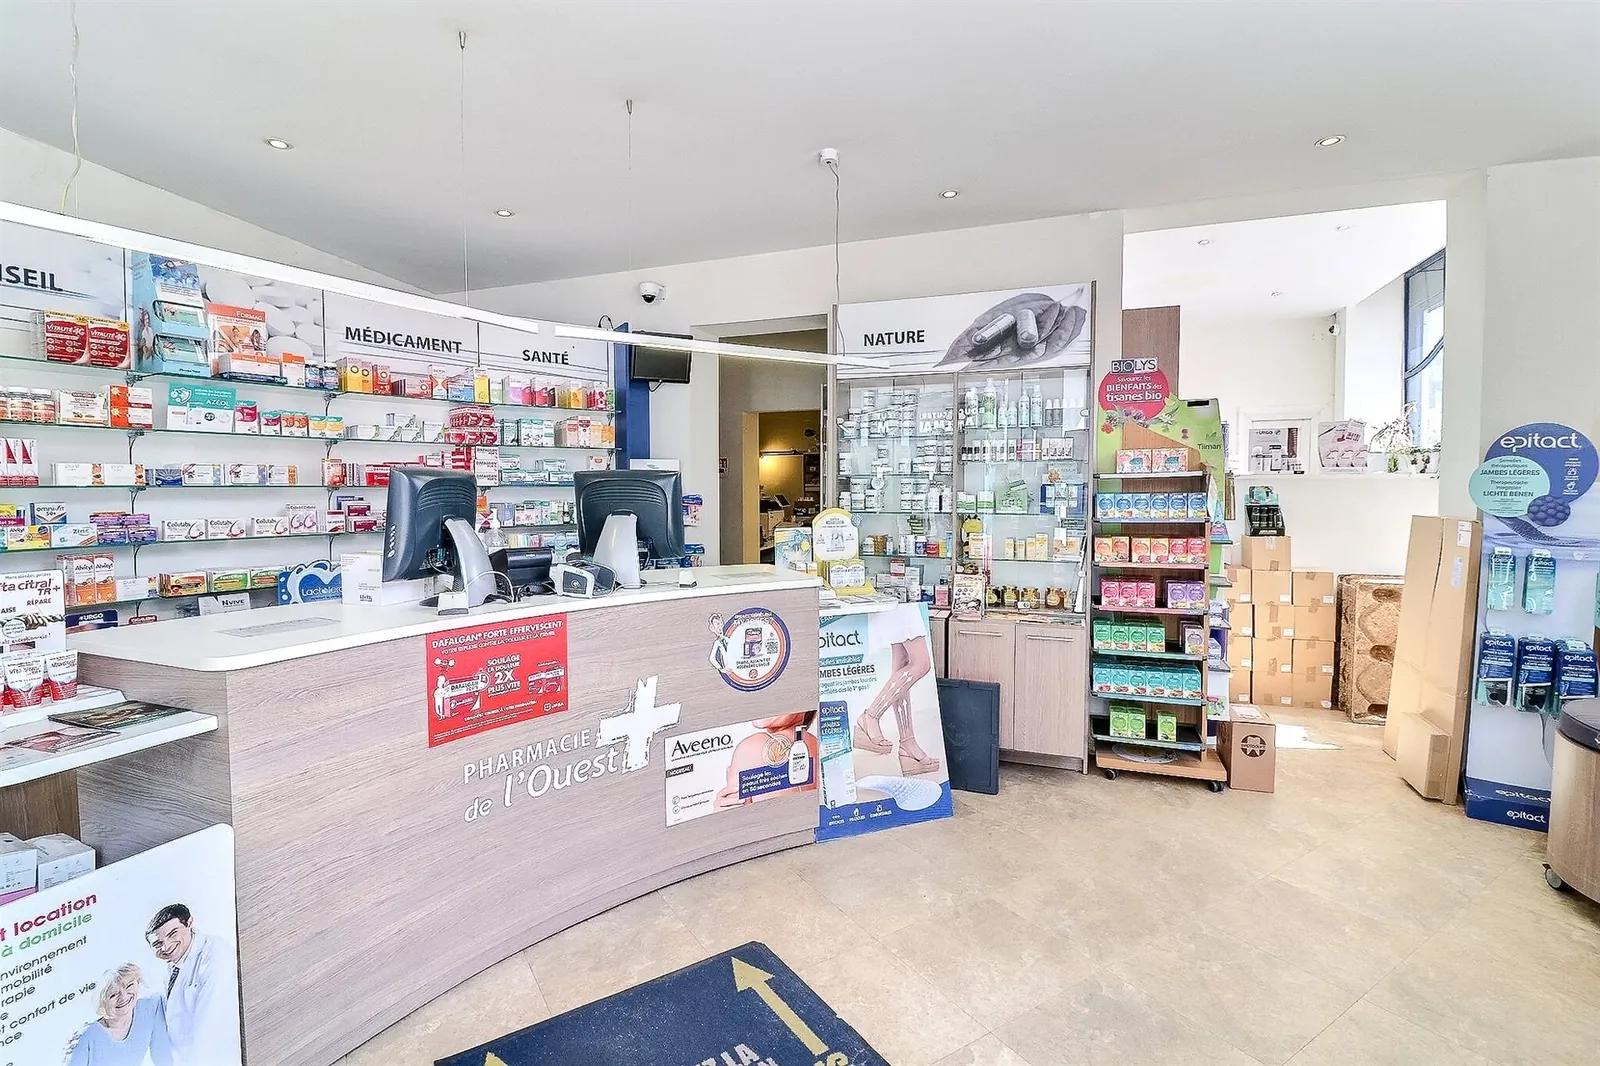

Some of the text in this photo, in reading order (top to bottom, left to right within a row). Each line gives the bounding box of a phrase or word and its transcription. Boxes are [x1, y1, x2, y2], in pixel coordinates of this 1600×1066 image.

[0, 263, 63, 291] SEIL
[345, 326, 462, 354] MÉDICAMENT
[863, 329, 925, 347] NATURE
[522, 349, 569, 365] SANTÉ
[1112, 359, 1157, 373] BIOLYS
[1106, 382, 1151, 392] BIENFAITS
[1106, 390, 1162, 402] tisanes bio
[1500, 432, 1582, 453] epitact
[18, 578, 51, 591] citral
[83, 613, 104, 621] URGO
[484, 628, 508, 639] FORTE
[509, 620, 563, 634] EFFERVESCENT
[487, 654, 520, 666] SOULAGE
[495, 669, 515, 684] 2X
[843, 664, 875, 677] LÉGÈRES
[488, 680, 521, 694] PLUS VITE
[671, 732, 732, 757] Aveeno
[463, 729, 592, 785] PHARMACIE
[464, 797, 493, 823] de
[503, 746, 619, 808] l'Ouest
[1506, 810, 1547, 823] epitact
[13, 893, 97, 937] location
[1, 912, 93, 958] à domicile
[0, 963, 53, 995] mobilité
[9, 1000, 56, 1030] confort
[59, 992, 76, 1006] de
[79, 982, 97, 995] vie
